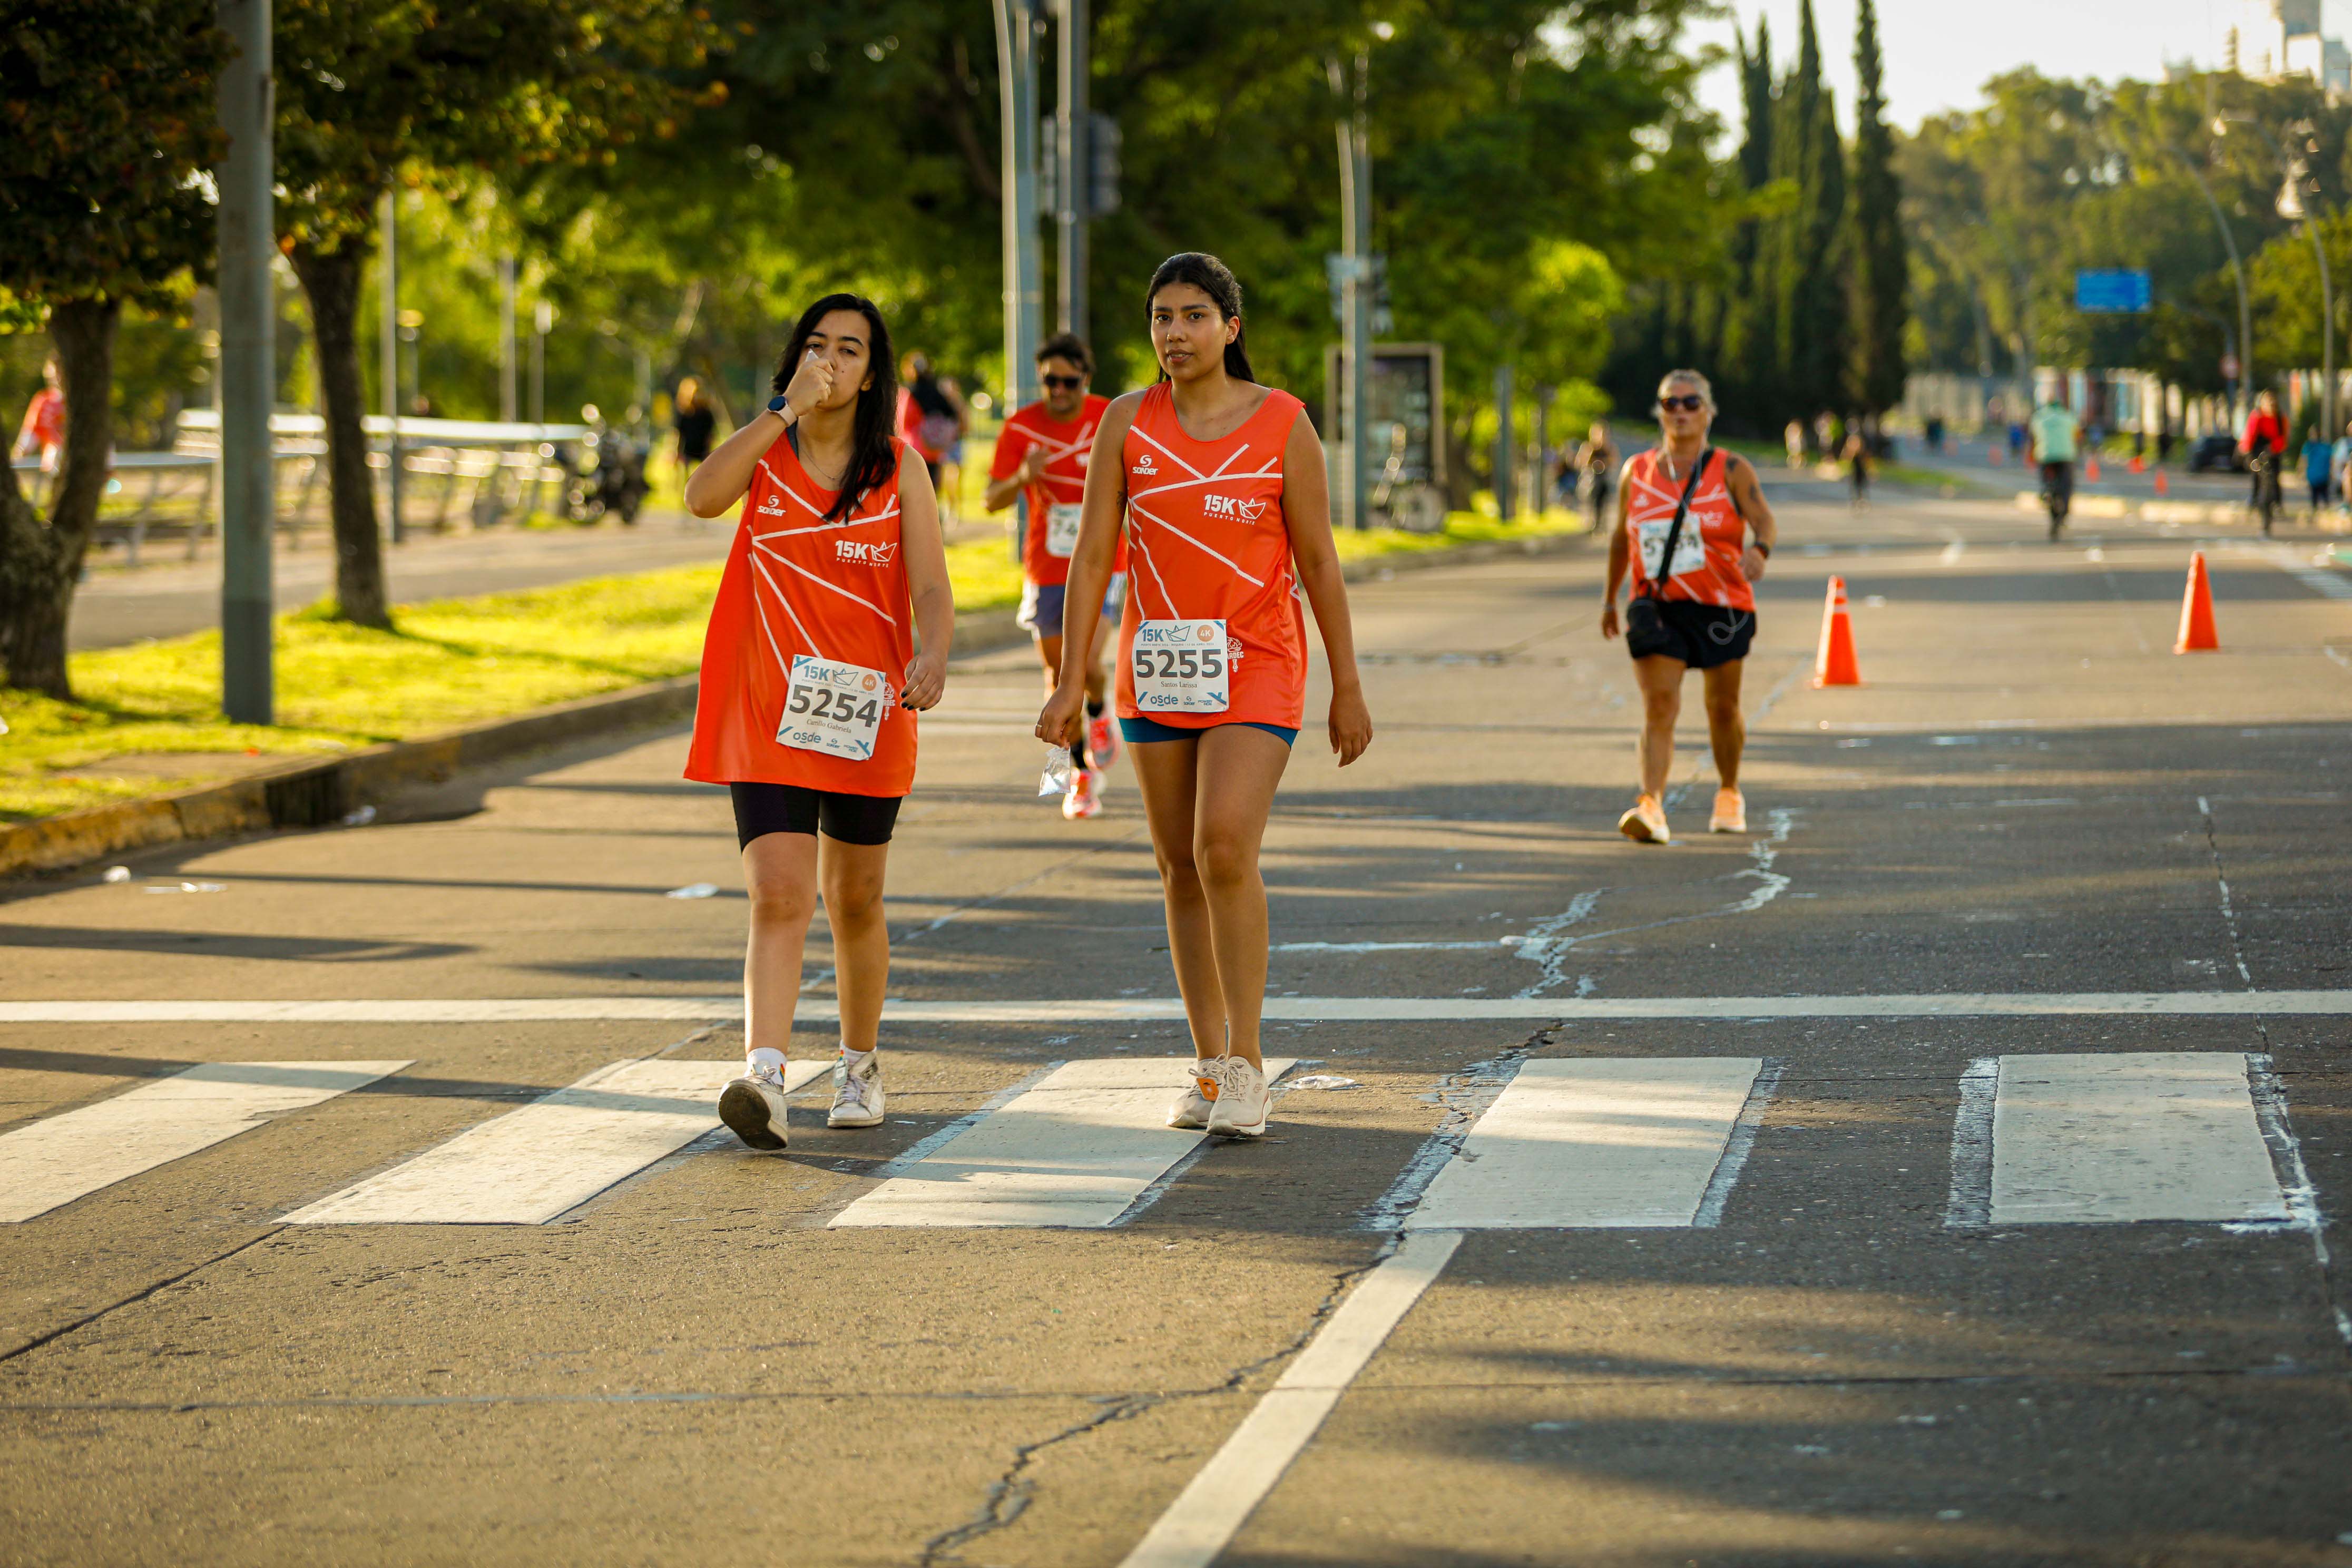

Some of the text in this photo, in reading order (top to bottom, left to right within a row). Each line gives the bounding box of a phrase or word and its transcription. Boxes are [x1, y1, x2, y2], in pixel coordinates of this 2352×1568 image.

[1204, 494, 1237, 515] 15K
[1203, 512, 1233, 521] PUERTO
[835, 540, 870, 560] 15K
[1142, 629, 1164, 642] 15K
[1136, 649, 1222, 679] 5255
[803, 665, 830, 681] 15K
[789, 684, 877, 728] 5254
[1150, 694, 1179, 705] osde
[827, 722, 852, 733] Gabriela
[793, 732, 822, 743] osde
